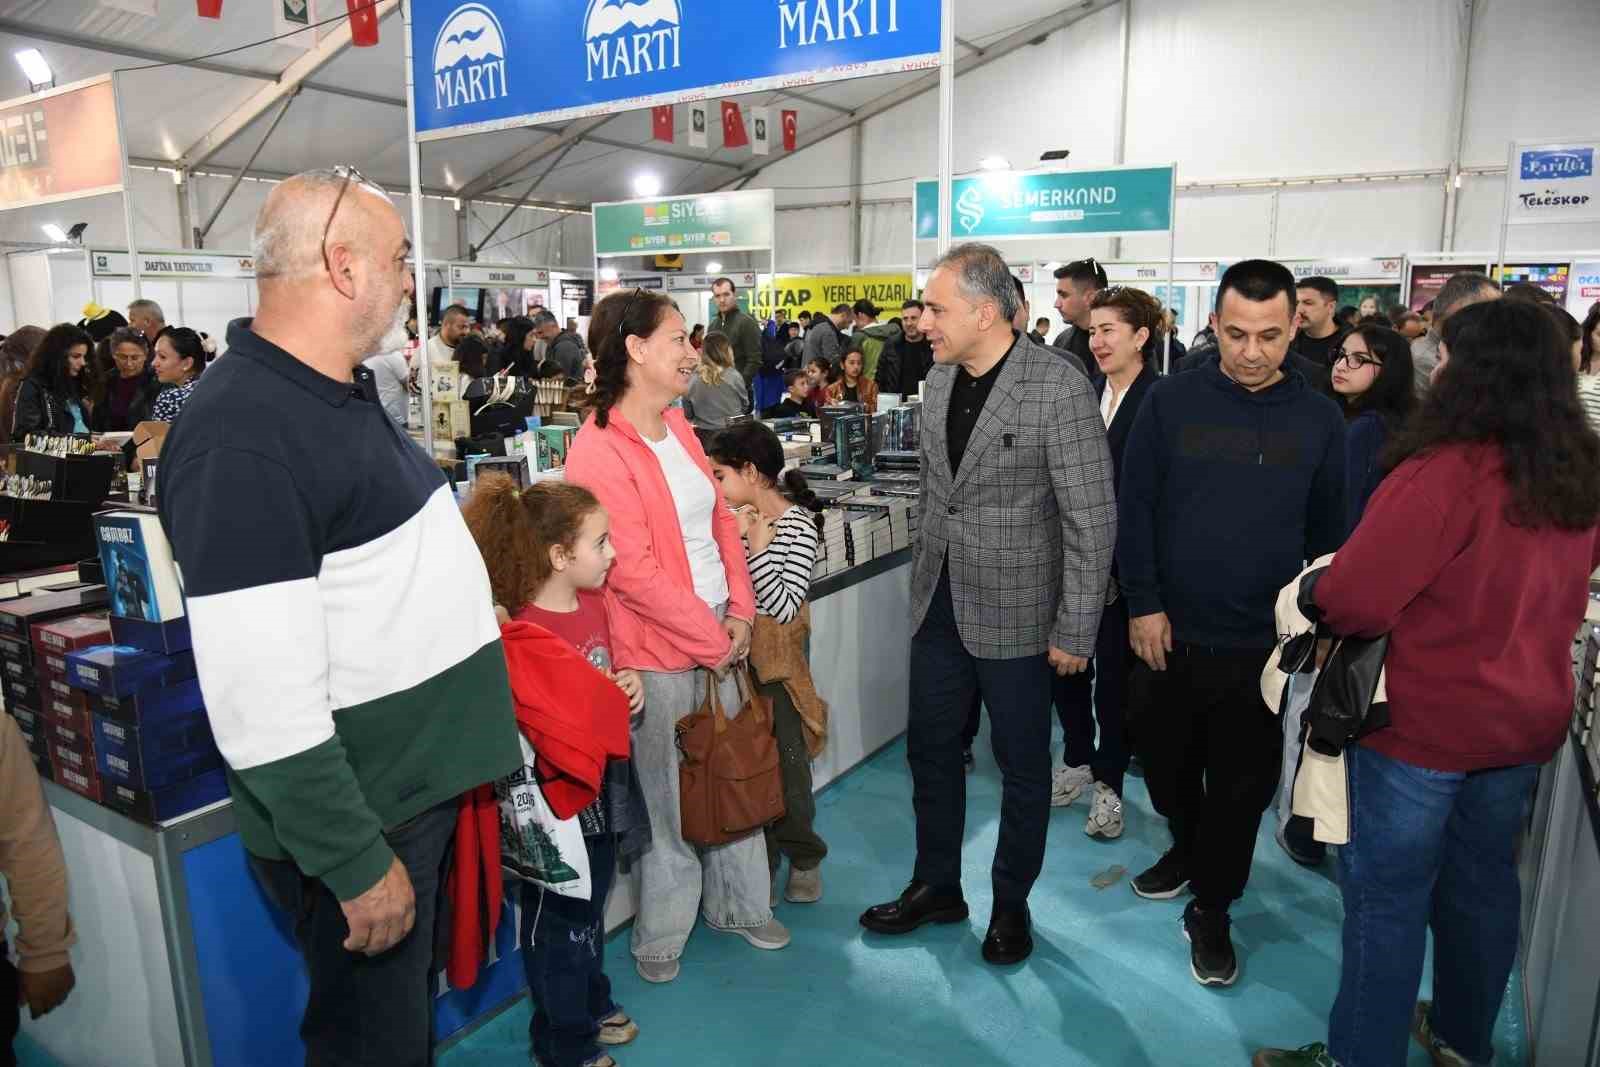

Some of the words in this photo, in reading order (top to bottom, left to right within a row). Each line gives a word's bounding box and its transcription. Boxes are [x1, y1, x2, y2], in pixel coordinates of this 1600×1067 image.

[585, 26, 681, 82] MARTI
[434, 58, 508, 110] MARTI
[823, 284, 857, 304] YEREL
